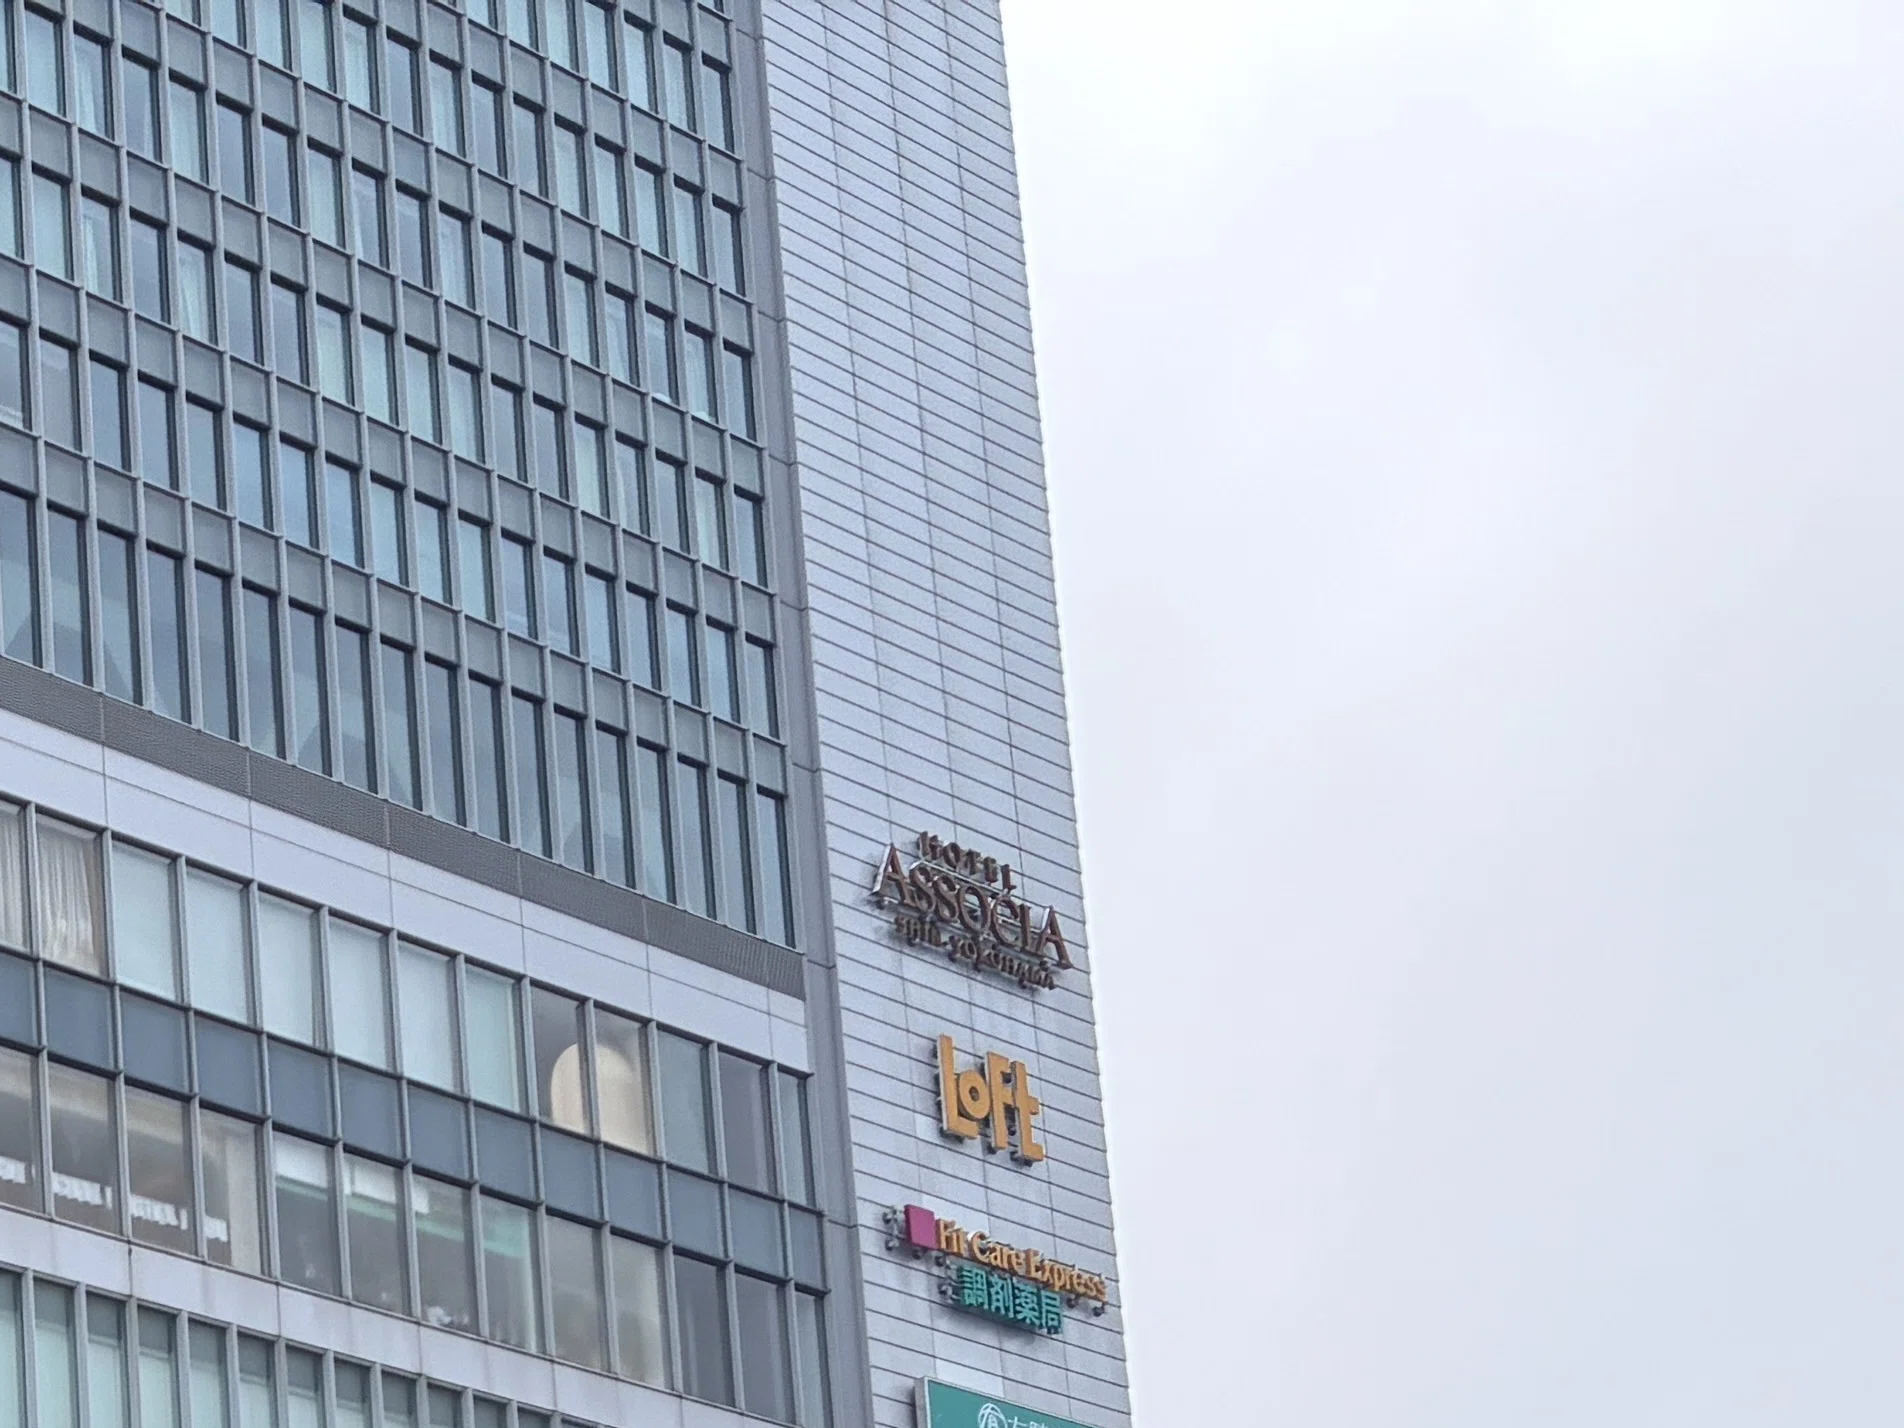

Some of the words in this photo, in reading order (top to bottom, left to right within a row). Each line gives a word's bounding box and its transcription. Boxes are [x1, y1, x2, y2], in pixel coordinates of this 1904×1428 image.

[870, 843, 1073, 970] ASSOCIA
[961, 1264, 1064, 1335] 調剤薬局
[969, 1231, 1025, 1274] Care
[1028, 1248, 1108, 1304] Express
